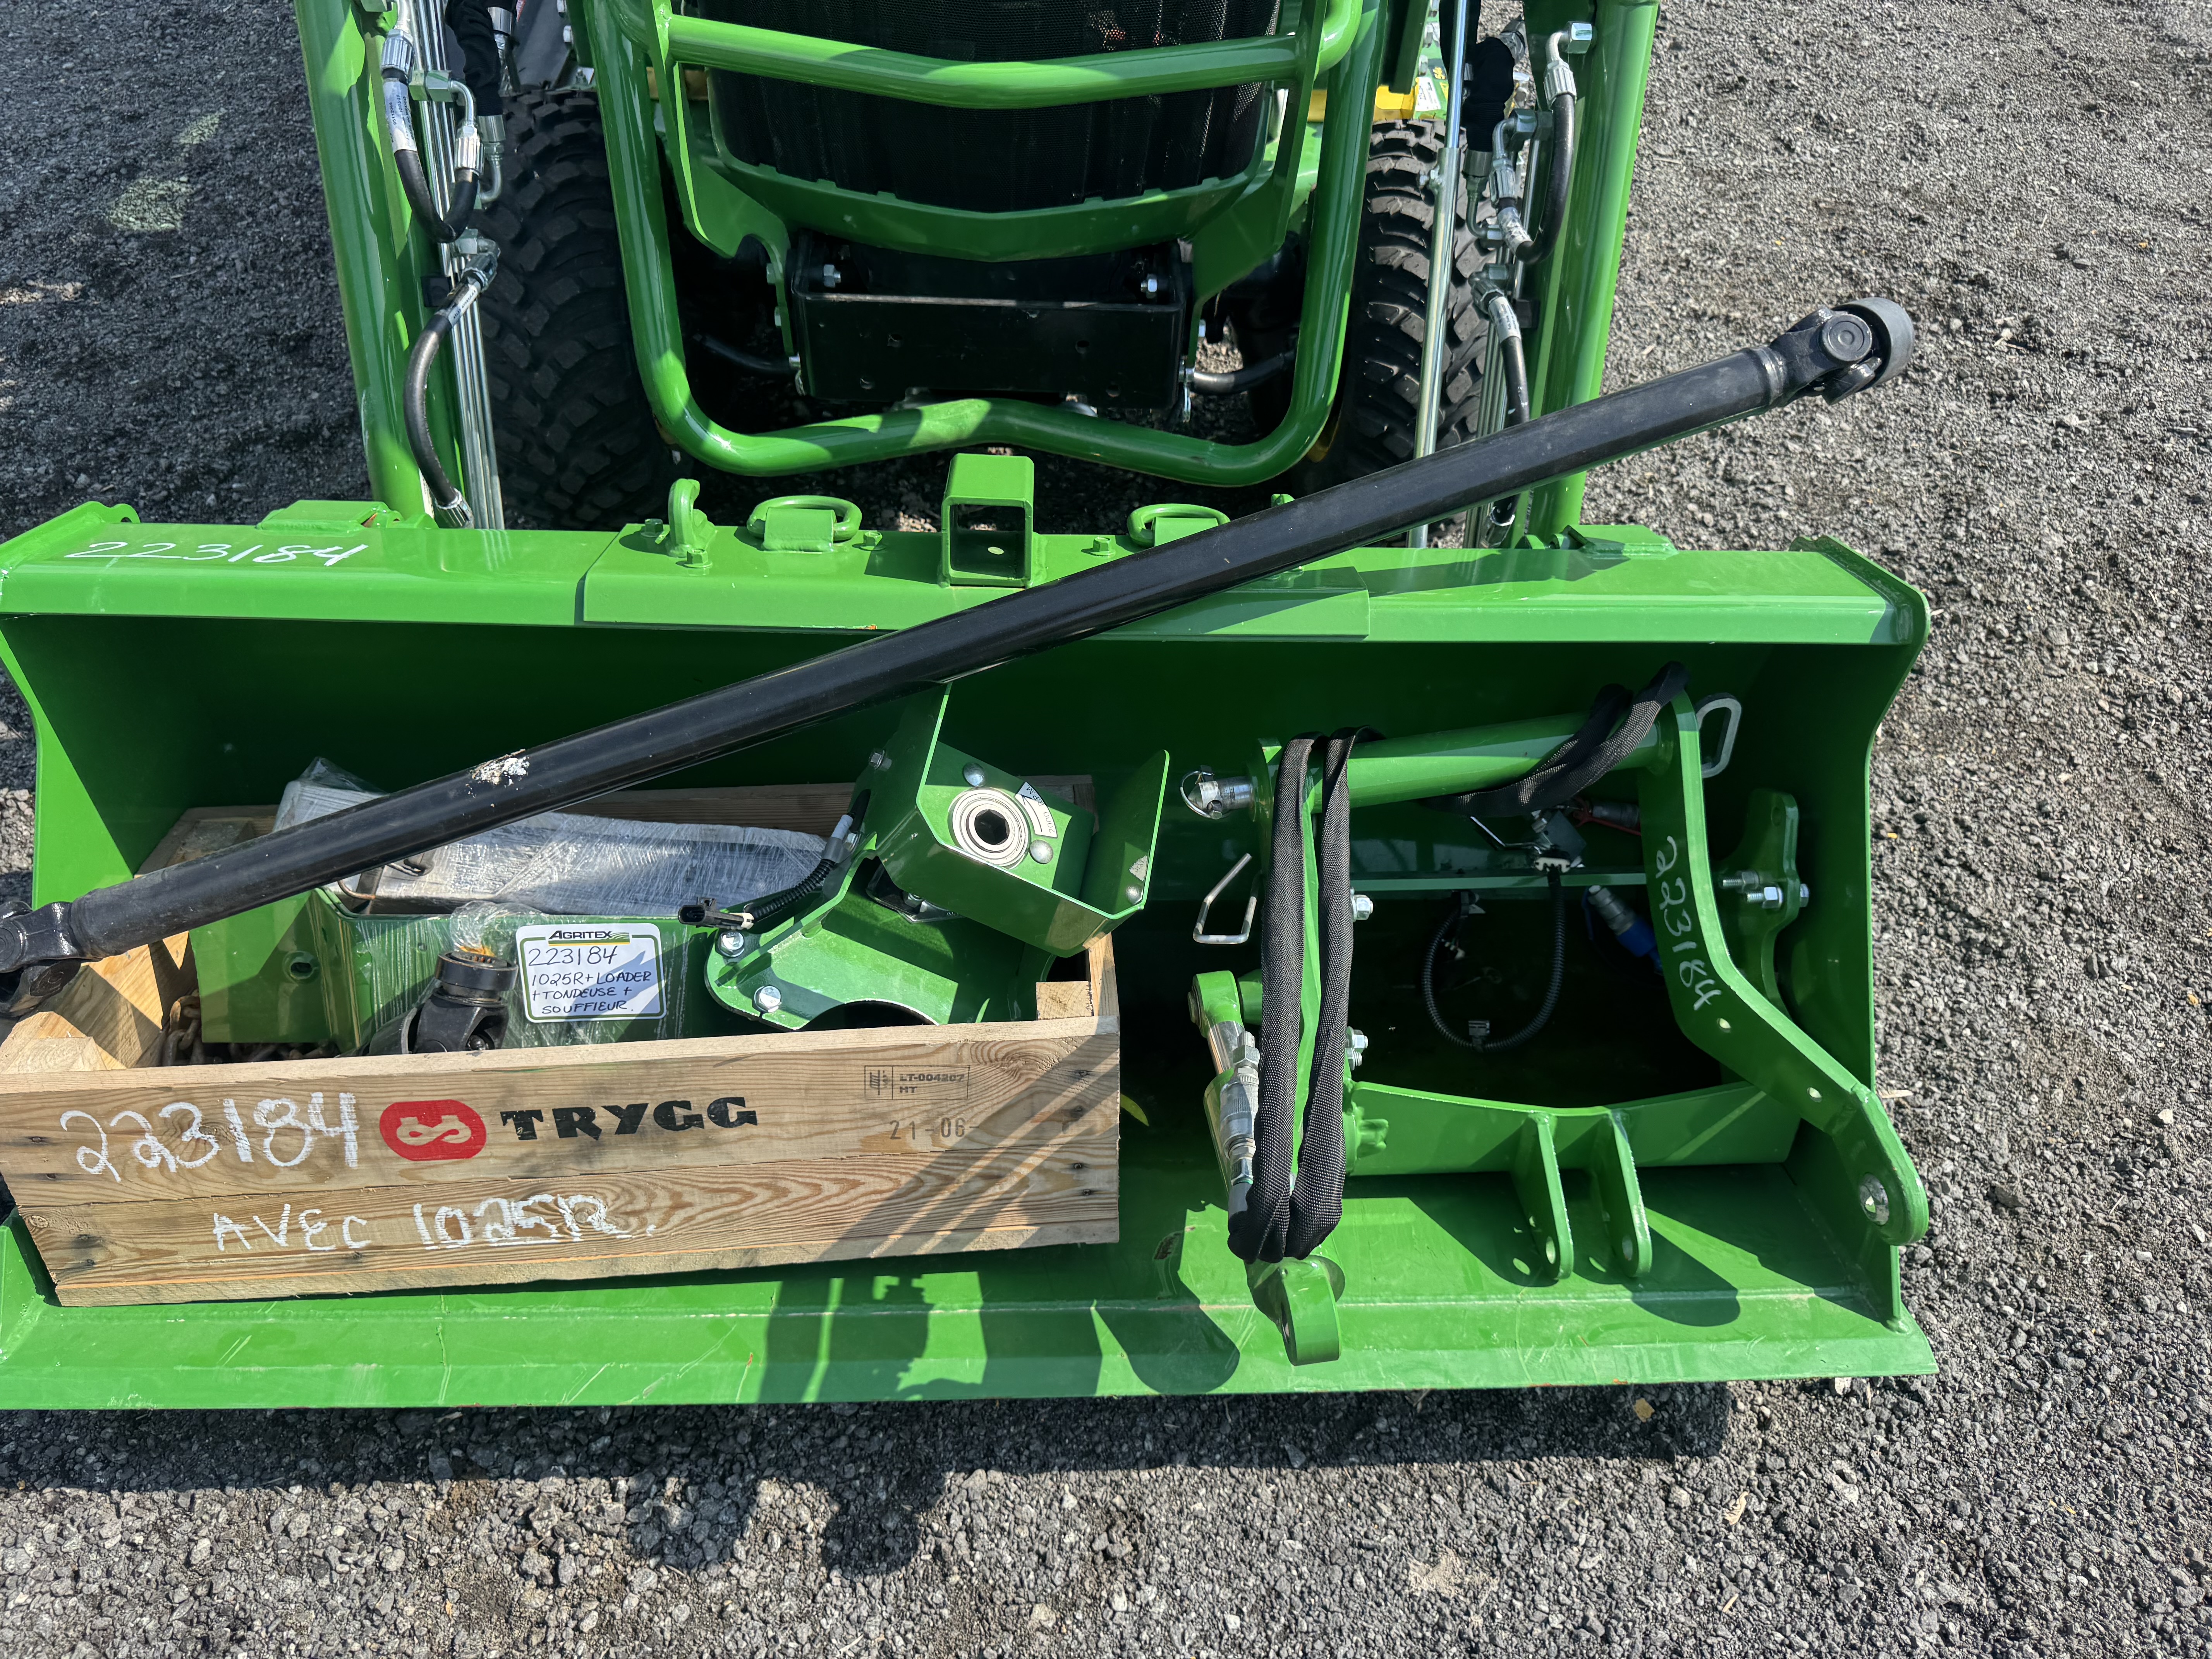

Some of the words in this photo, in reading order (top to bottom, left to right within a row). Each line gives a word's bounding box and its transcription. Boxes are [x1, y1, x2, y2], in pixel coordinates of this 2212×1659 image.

[64, 541, 369, 567] 223184
[1043, 812, 1055, 833] 2000
[548, 930, 612, 939] AGRITEX
[1655, 835, 1722, 1011] 223184
[528, 945, 618, 966] 223184
[500, 1097, 758, 1141] TRYGG
[60, 1092, 359, 1182] 223184
[213, 1203, 372, 1251] AVEC
